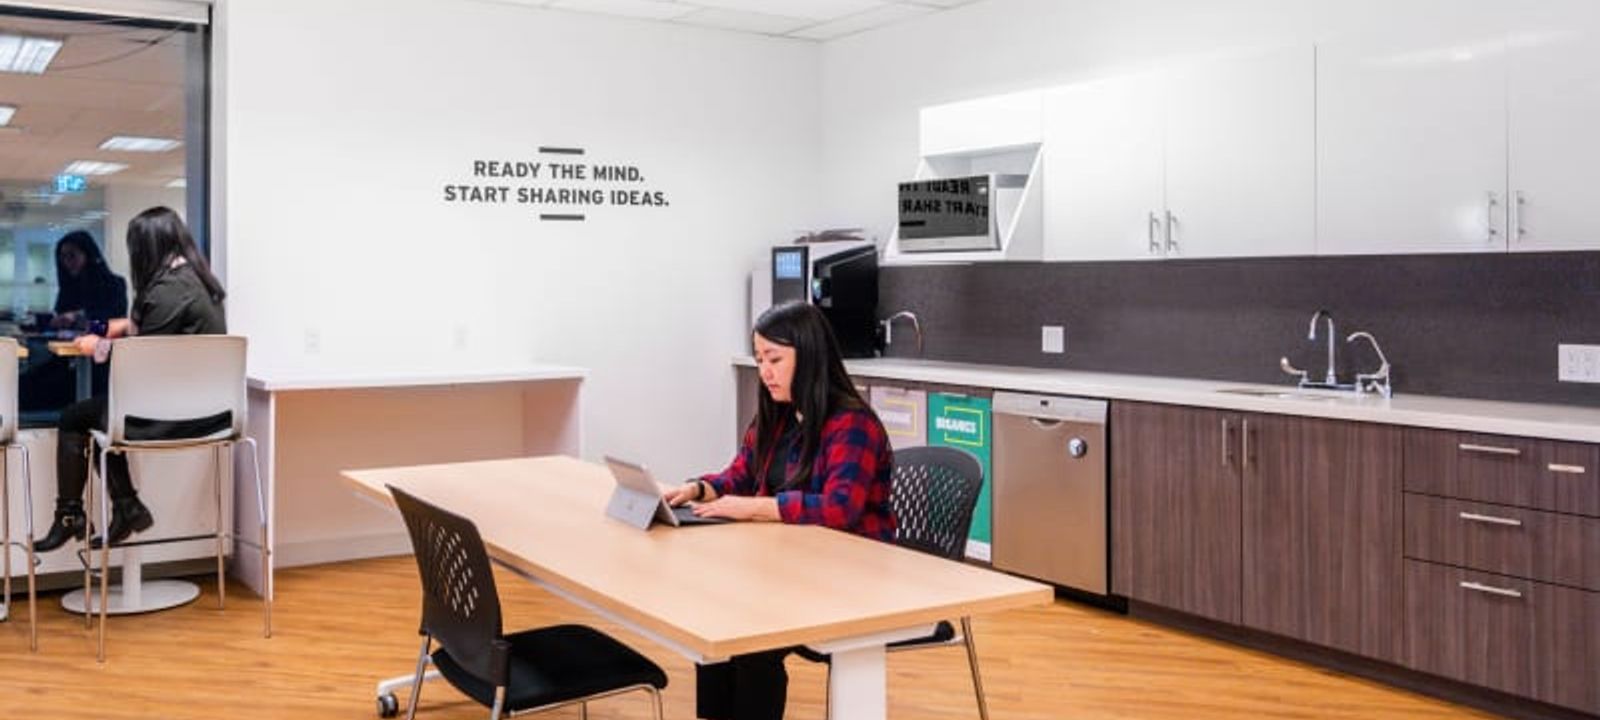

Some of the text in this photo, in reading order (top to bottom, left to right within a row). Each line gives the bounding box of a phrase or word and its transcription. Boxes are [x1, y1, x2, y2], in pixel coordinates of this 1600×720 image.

[473, 160, 645, 182] READY THE MIND.
[444, 185, 670, 207] START SHARING IDEAS.
